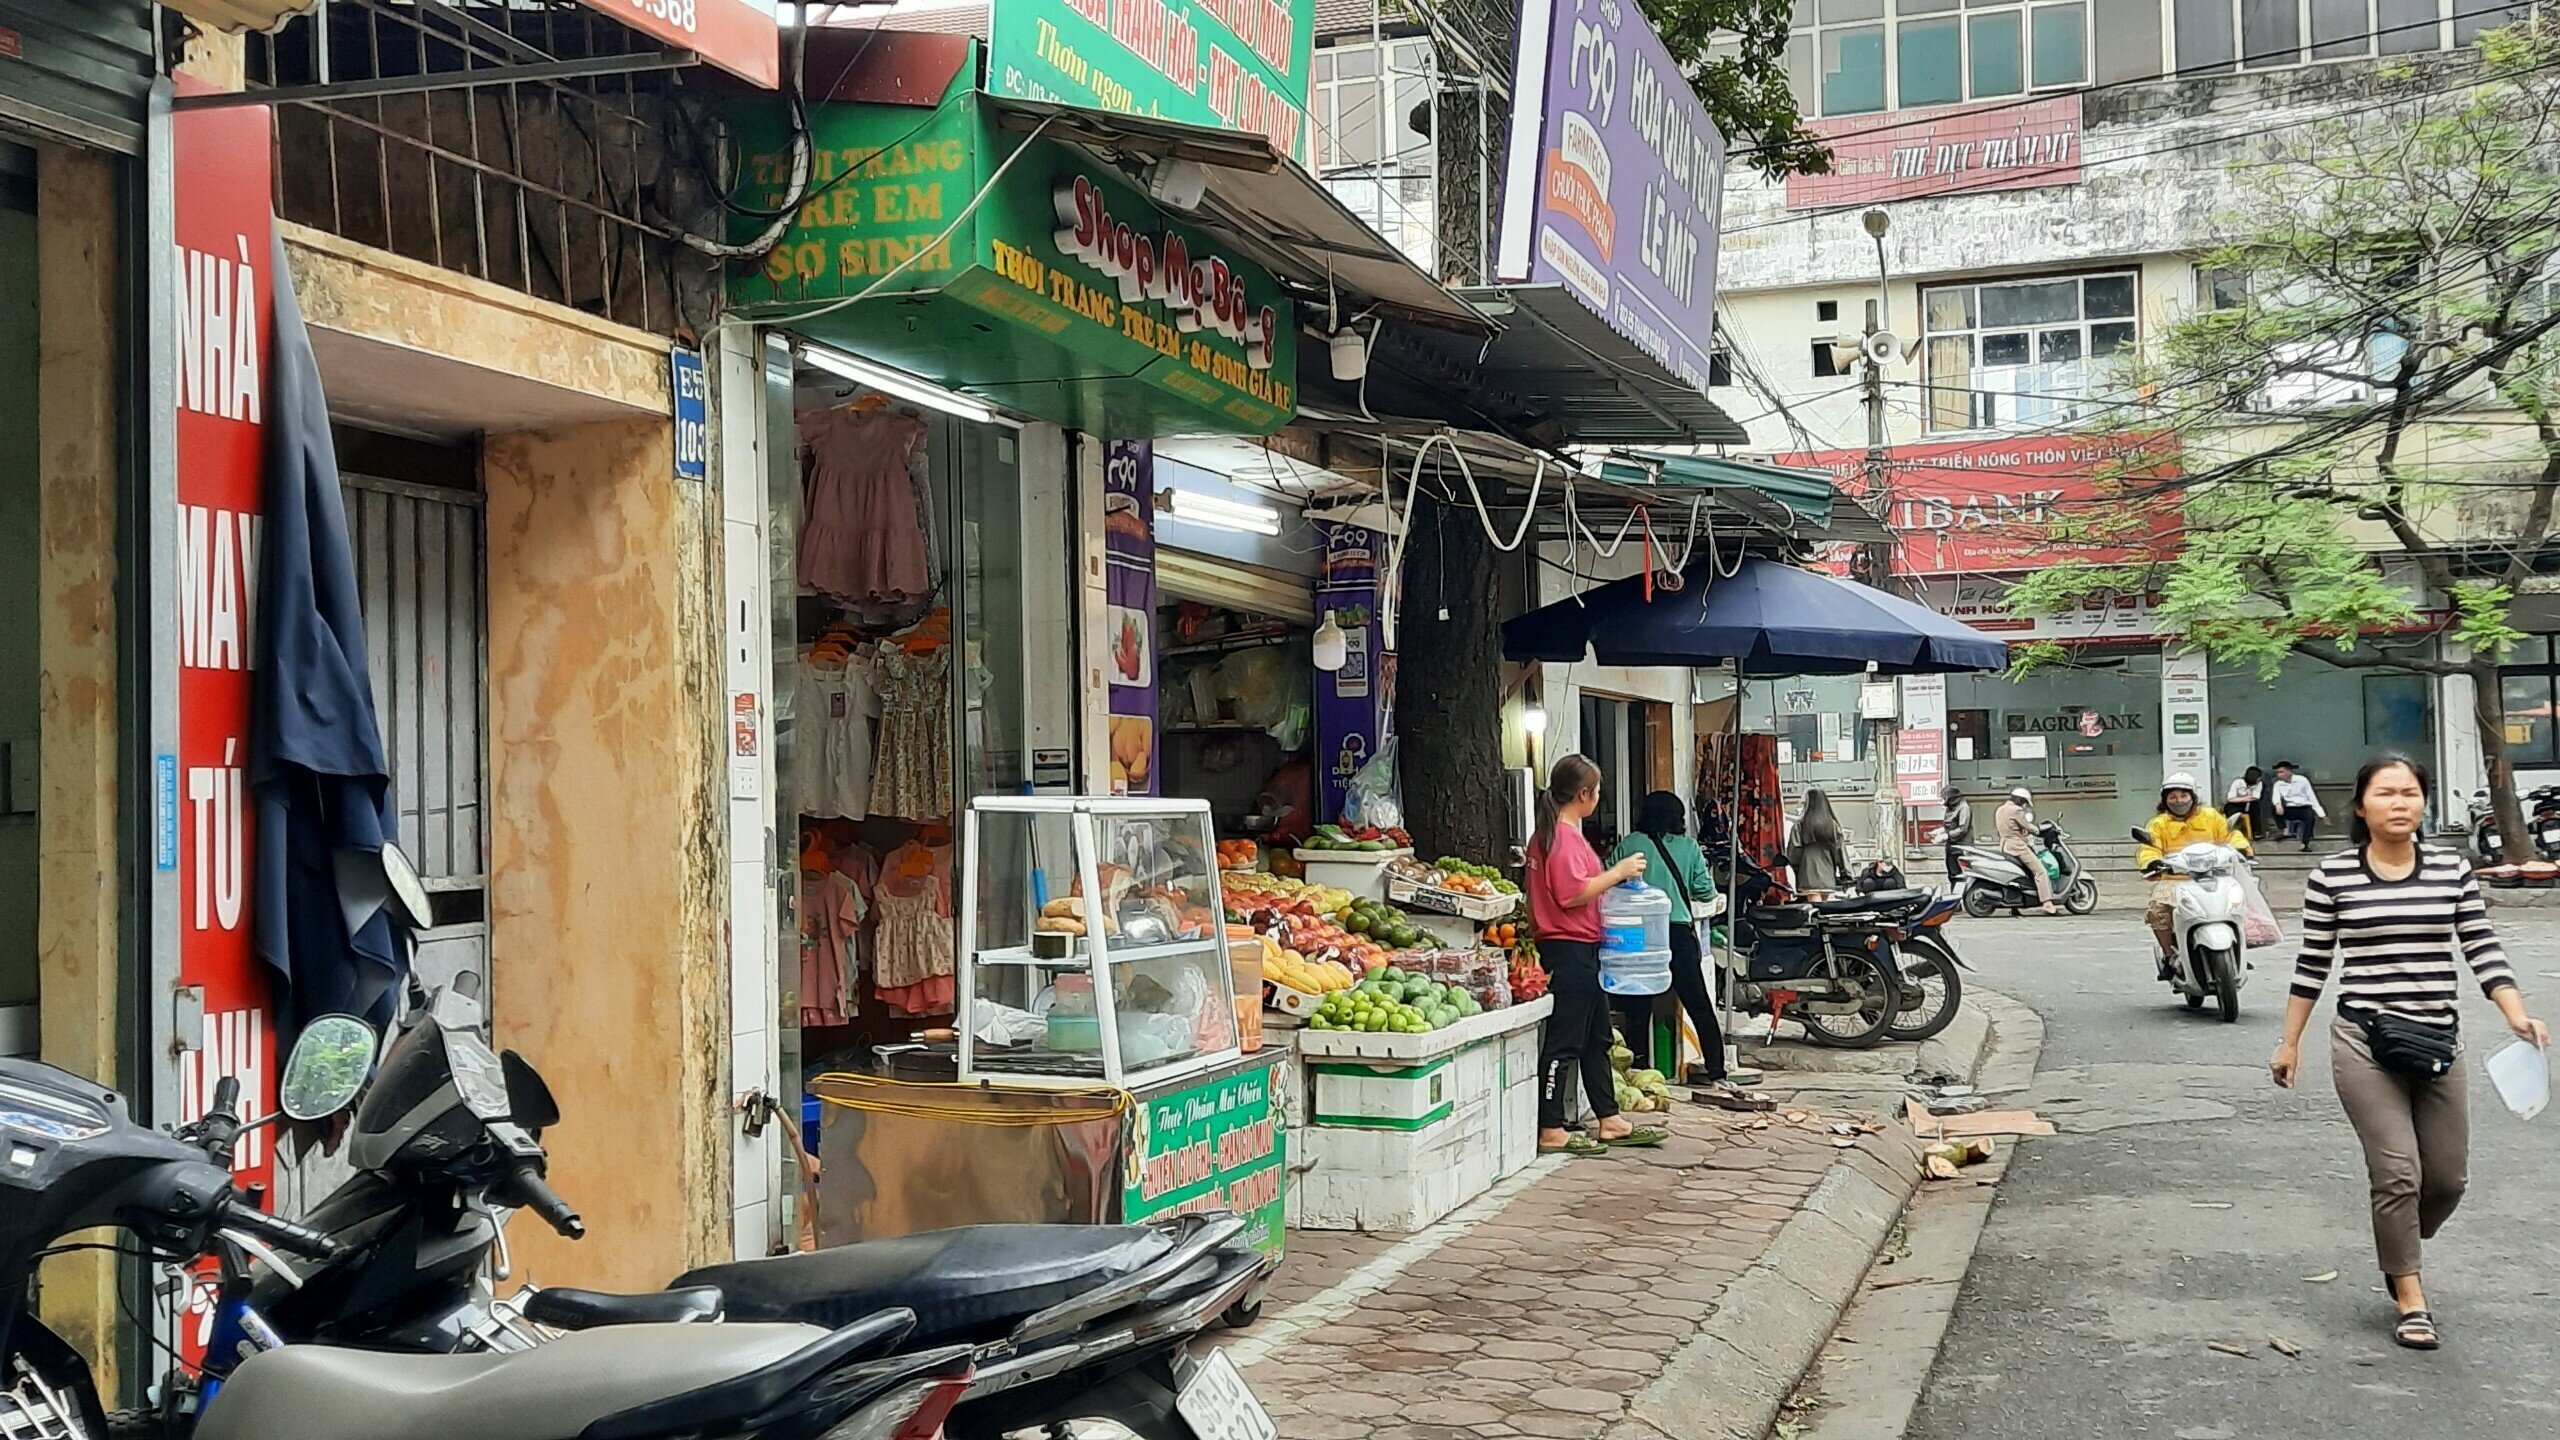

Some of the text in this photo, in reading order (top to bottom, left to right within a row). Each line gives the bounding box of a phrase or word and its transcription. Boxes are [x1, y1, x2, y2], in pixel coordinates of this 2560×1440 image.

[1036, 17, 1089, 86] Thơm
[1091, 68, 1133, 112] ngon
[1265, 90, 1301, 160] QUAY
[1567, 121, 1608, 191] FARMTECH
[1629, 48, 1664, 158] HOA
[1663, 97, 1694, 194] QUẢ
[751, 138, 965, 186] THI TRANG
[872, 183, 944, 224] EM
[766, 232, 951, 282] SƠ SINH
[1072, 174, 1157, 297] Shop
[1162, 229, 1206, 328] Mẹ
[1640, 173, 1667, 279] LÊ
[1663, 206, 1699, 310] MÍT
[174, 234, 263, 425] NHÀ
[992, 238, 1046, 296] THỜI
[1049, 267, 1116, 328] TRANG
[1120, 305, 1156, 350] TRẺ
[1155, 323, 1182, 361] EM
[1212, 351, 1248, 392] SINH
[1248, 368, 1273, 404] GIÁ
[678, 365, 704, 401] E5
[1929, 450, 1973, 470] TRIỂN
[1977, 451, 2021, 468] NÔNG
[2024, 447, 2067, 465] THÔN
[2027, 712, 2144, 733] AGRIANK
[188, 737, 242, 931] TÚ
